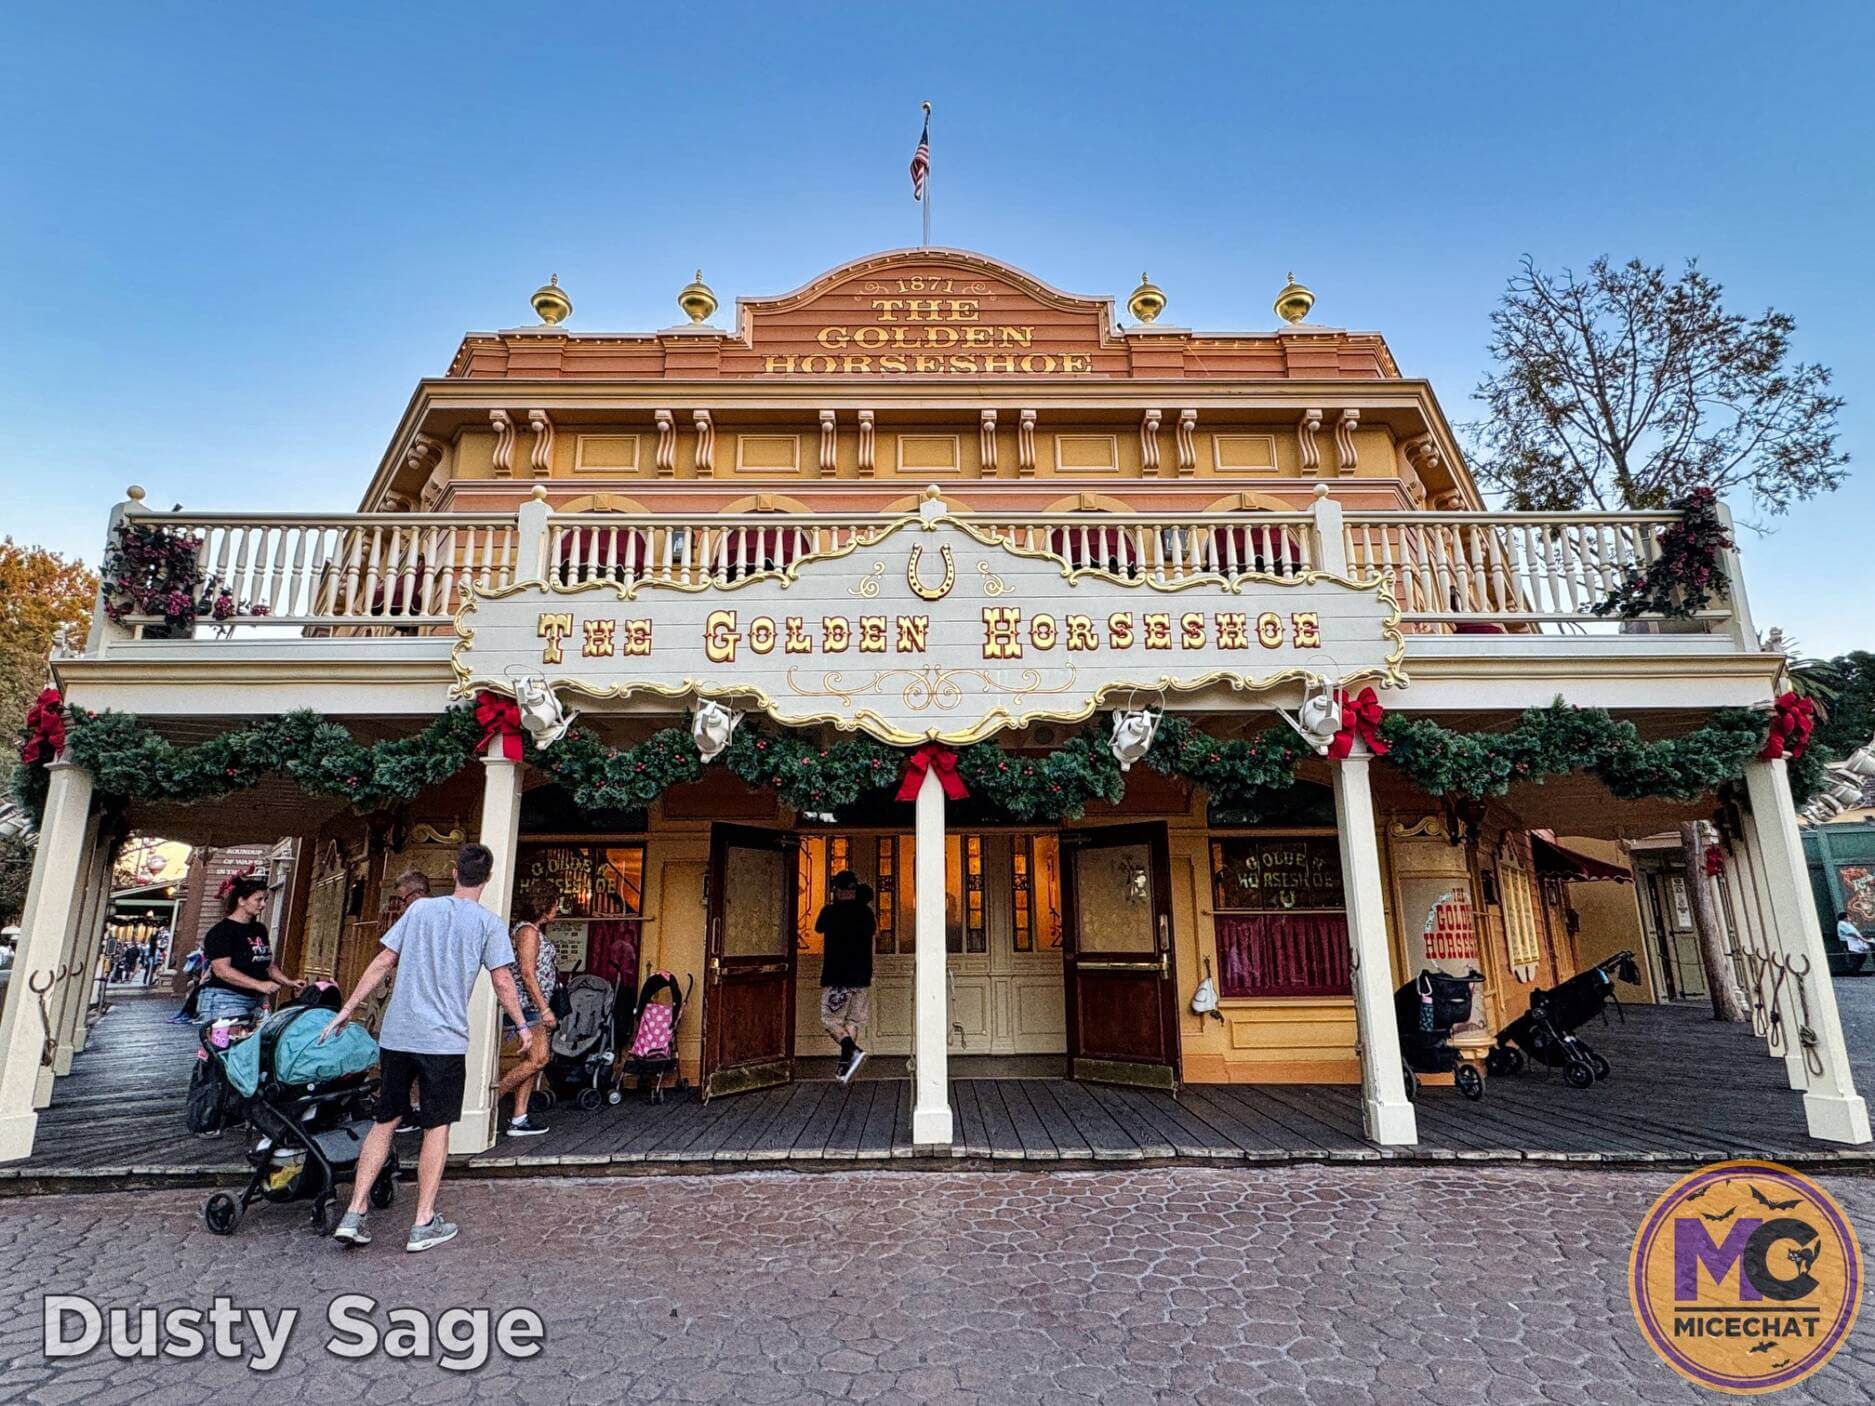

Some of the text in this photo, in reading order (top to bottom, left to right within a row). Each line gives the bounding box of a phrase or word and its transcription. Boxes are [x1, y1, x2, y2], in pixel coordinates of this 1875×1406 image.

[897, 276, 955, 293] 1871
[871, 299, 980, 321] THE
[816, 326, 1035, 349] GOLDEN
[762, 353, 1093, 375] HORSESHOE
[538, 606, 1322, 664] THE GOLDEN HORSESHOE
